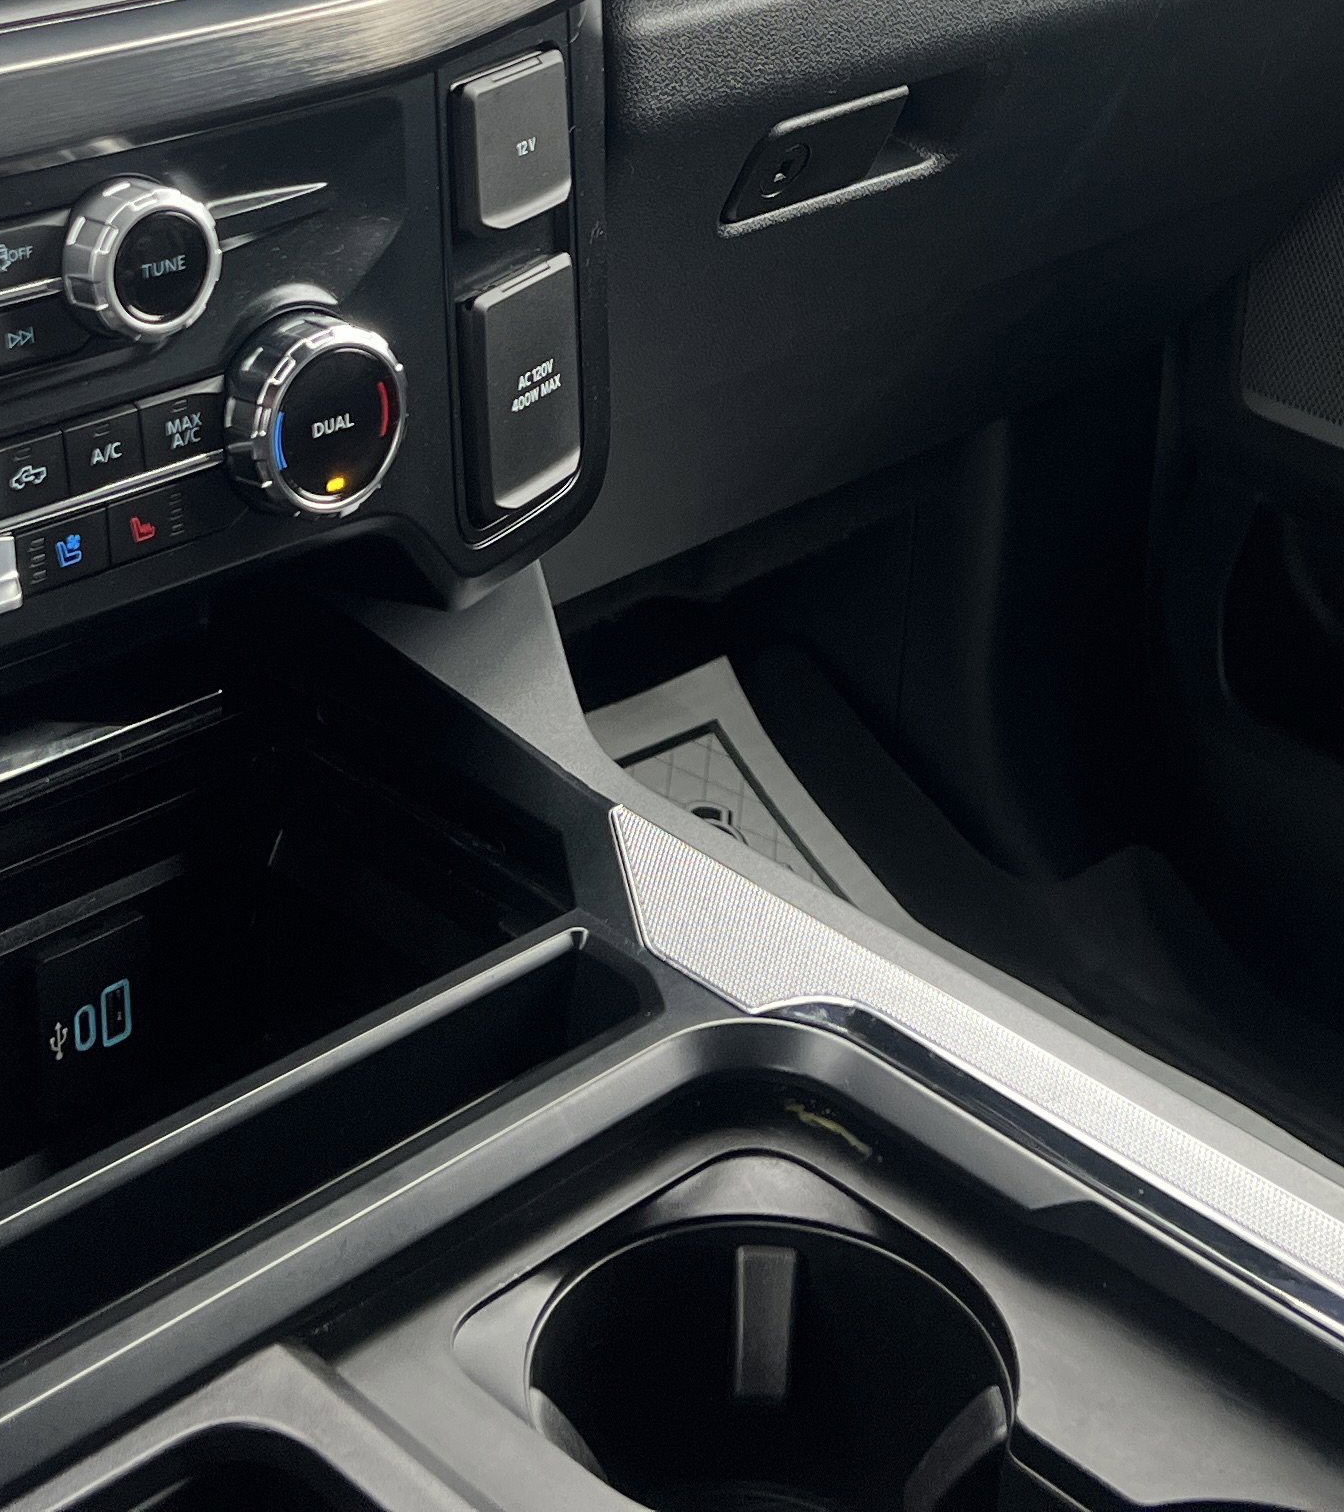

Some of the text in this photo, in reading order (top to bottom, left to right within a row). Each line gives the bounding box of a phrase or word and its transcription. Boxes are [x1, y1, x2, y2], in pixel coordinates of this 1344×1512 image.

[8, 244, 33, 262] OFF
[140, 253, 187, 279] TUNE
[518, 358, 554, 391] AC 120V
[511, 373, 562, 413] 400W MAX
[165, 412, 203, 437] MAX
[312, 413, 355, 440] DUAL
[169, 426, 203, 451] A/C
[90, 440, 123, 467] A/C
